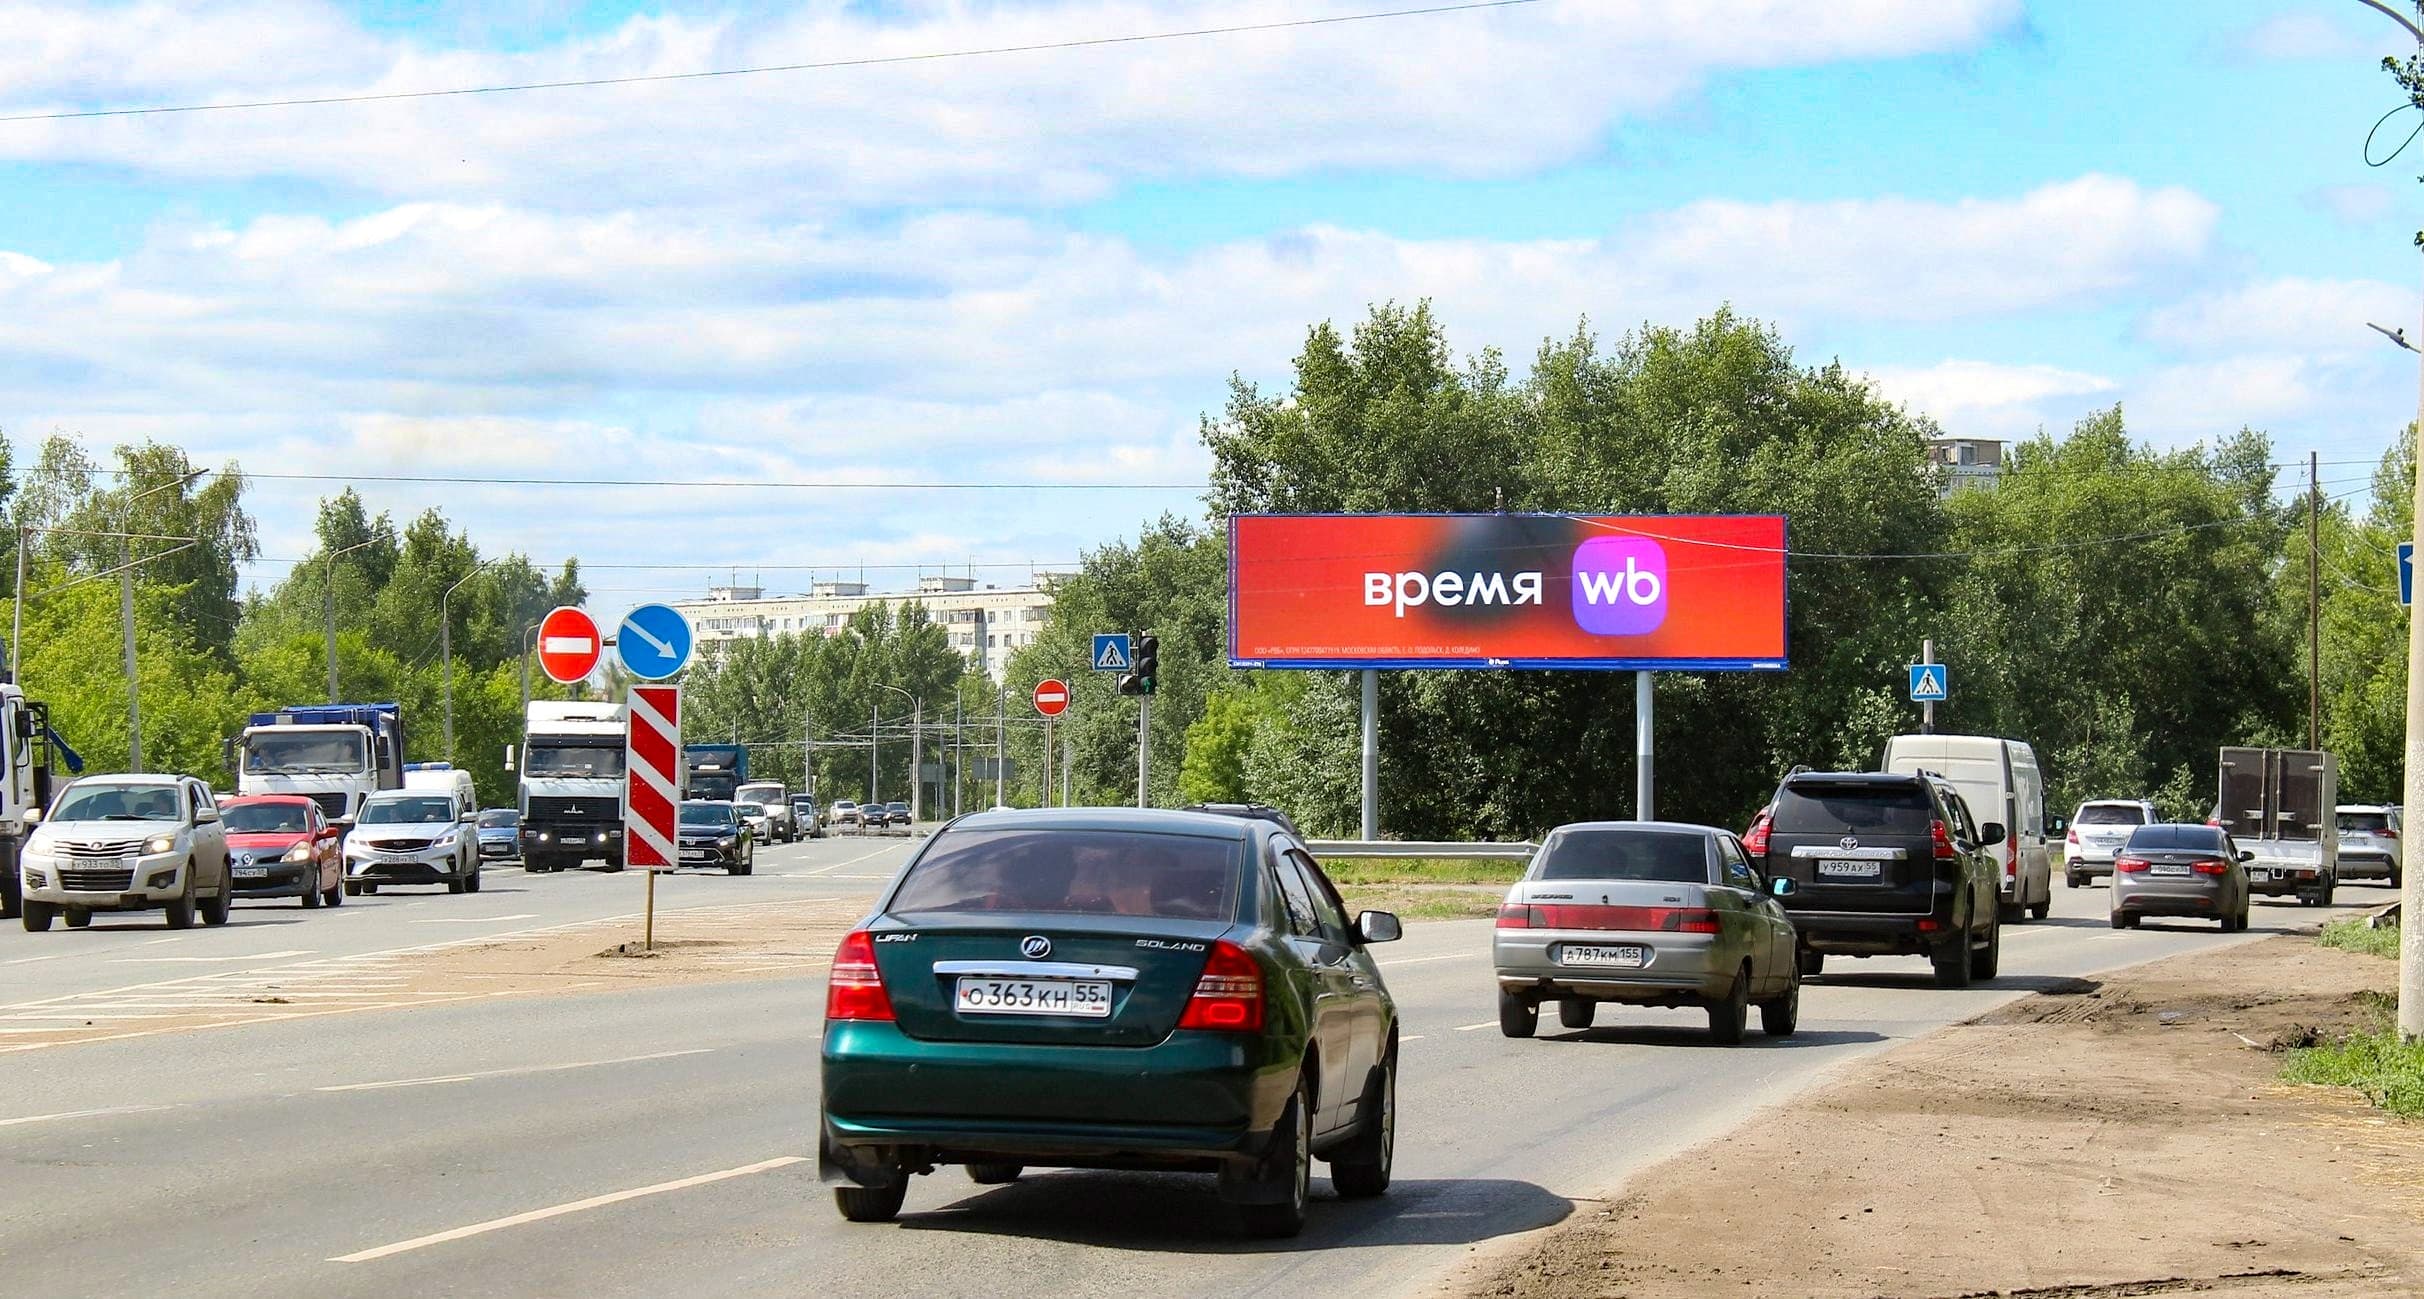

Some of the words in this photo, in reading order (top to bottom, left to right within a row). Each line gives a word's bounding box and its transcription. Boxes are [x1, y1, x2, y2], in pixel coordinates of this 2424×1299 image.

[1579, 556, 1660, 606] wb
[1364, 571, 1543, 618] время
[875, 933, 918, 943] LIFAN
[1135, 939, 1205, 952] SOLANO
[1567, 947, 1617, 961] А787КМ
[1619, 948, 1639, 959] 155
[968, 983, 1067, 1009] О363КН
[1075, 984, 1100, 1002] 55
